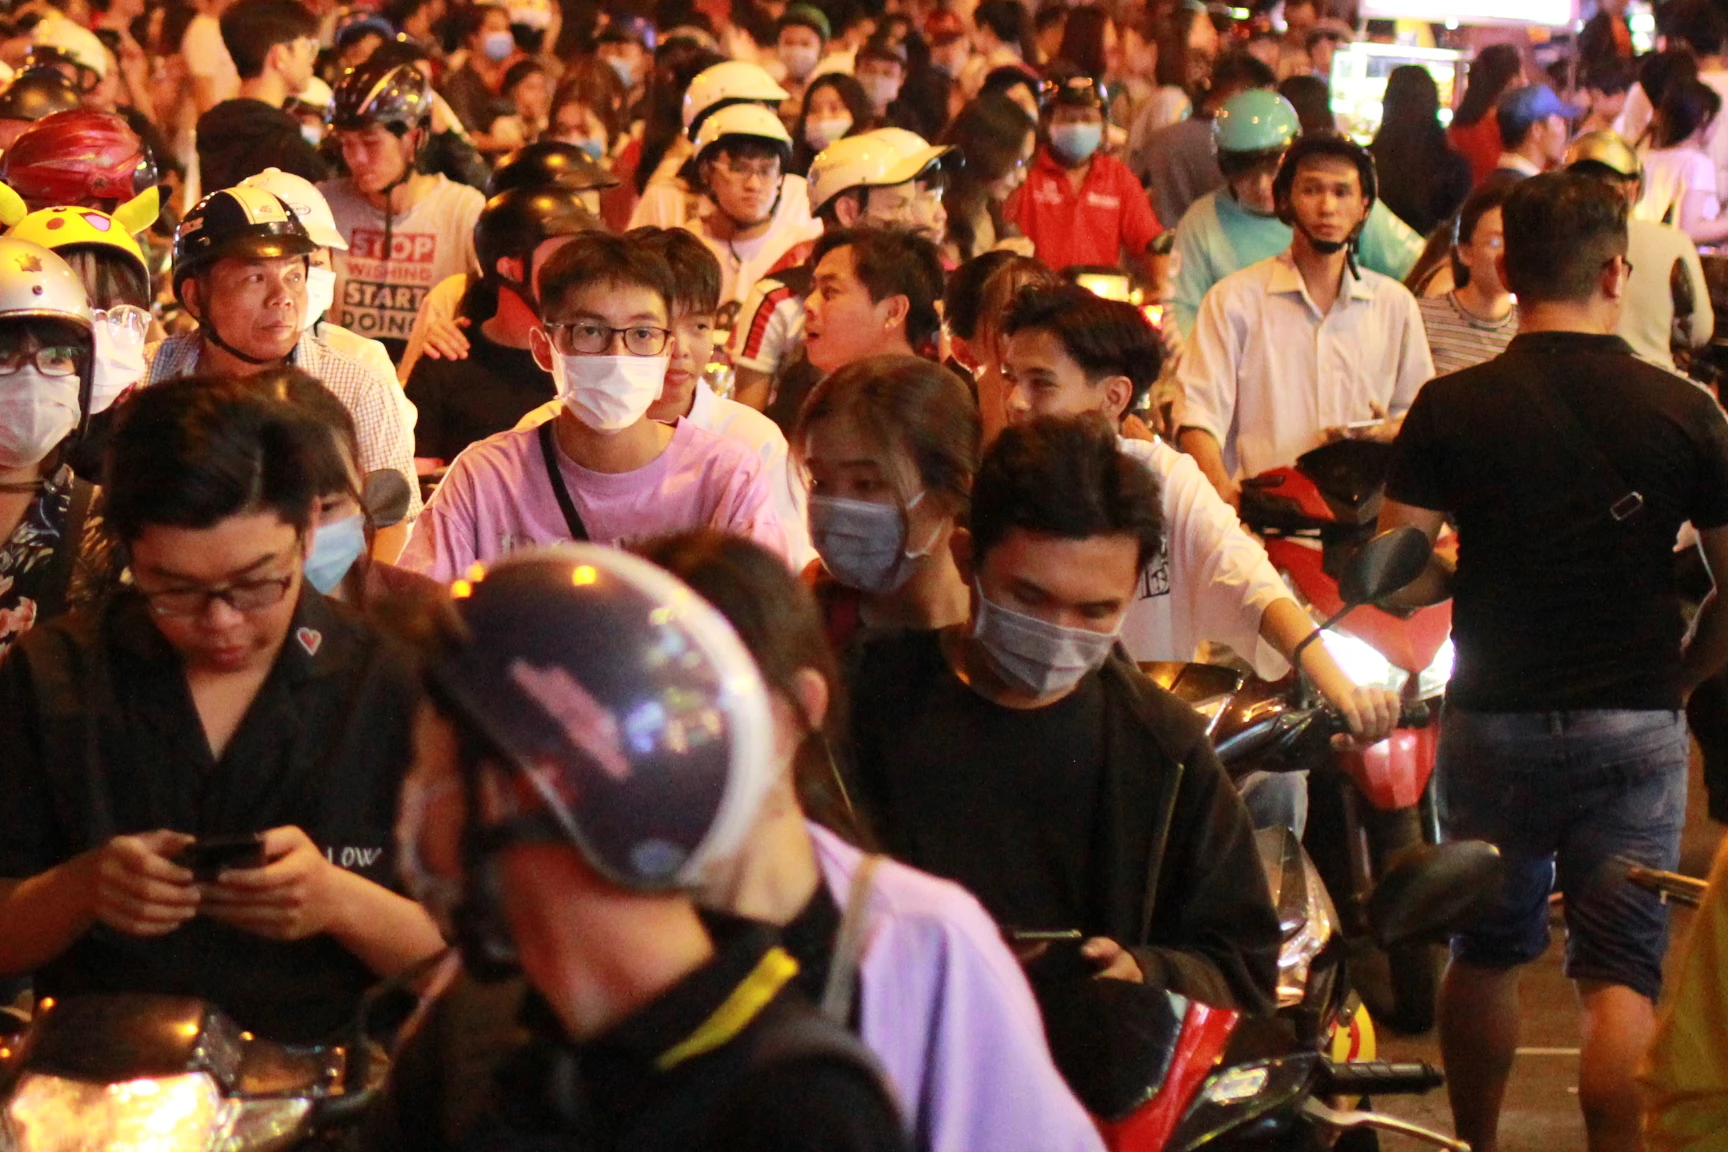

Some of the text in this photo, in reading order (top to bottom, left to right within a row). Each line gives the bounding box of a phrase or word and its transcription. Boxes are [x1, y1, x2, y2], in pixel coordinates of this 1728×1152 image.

[352, 231, 435, 261] STOP
[347, 261, 433, 281] WISHING
[347, 282, 430, 309] START
